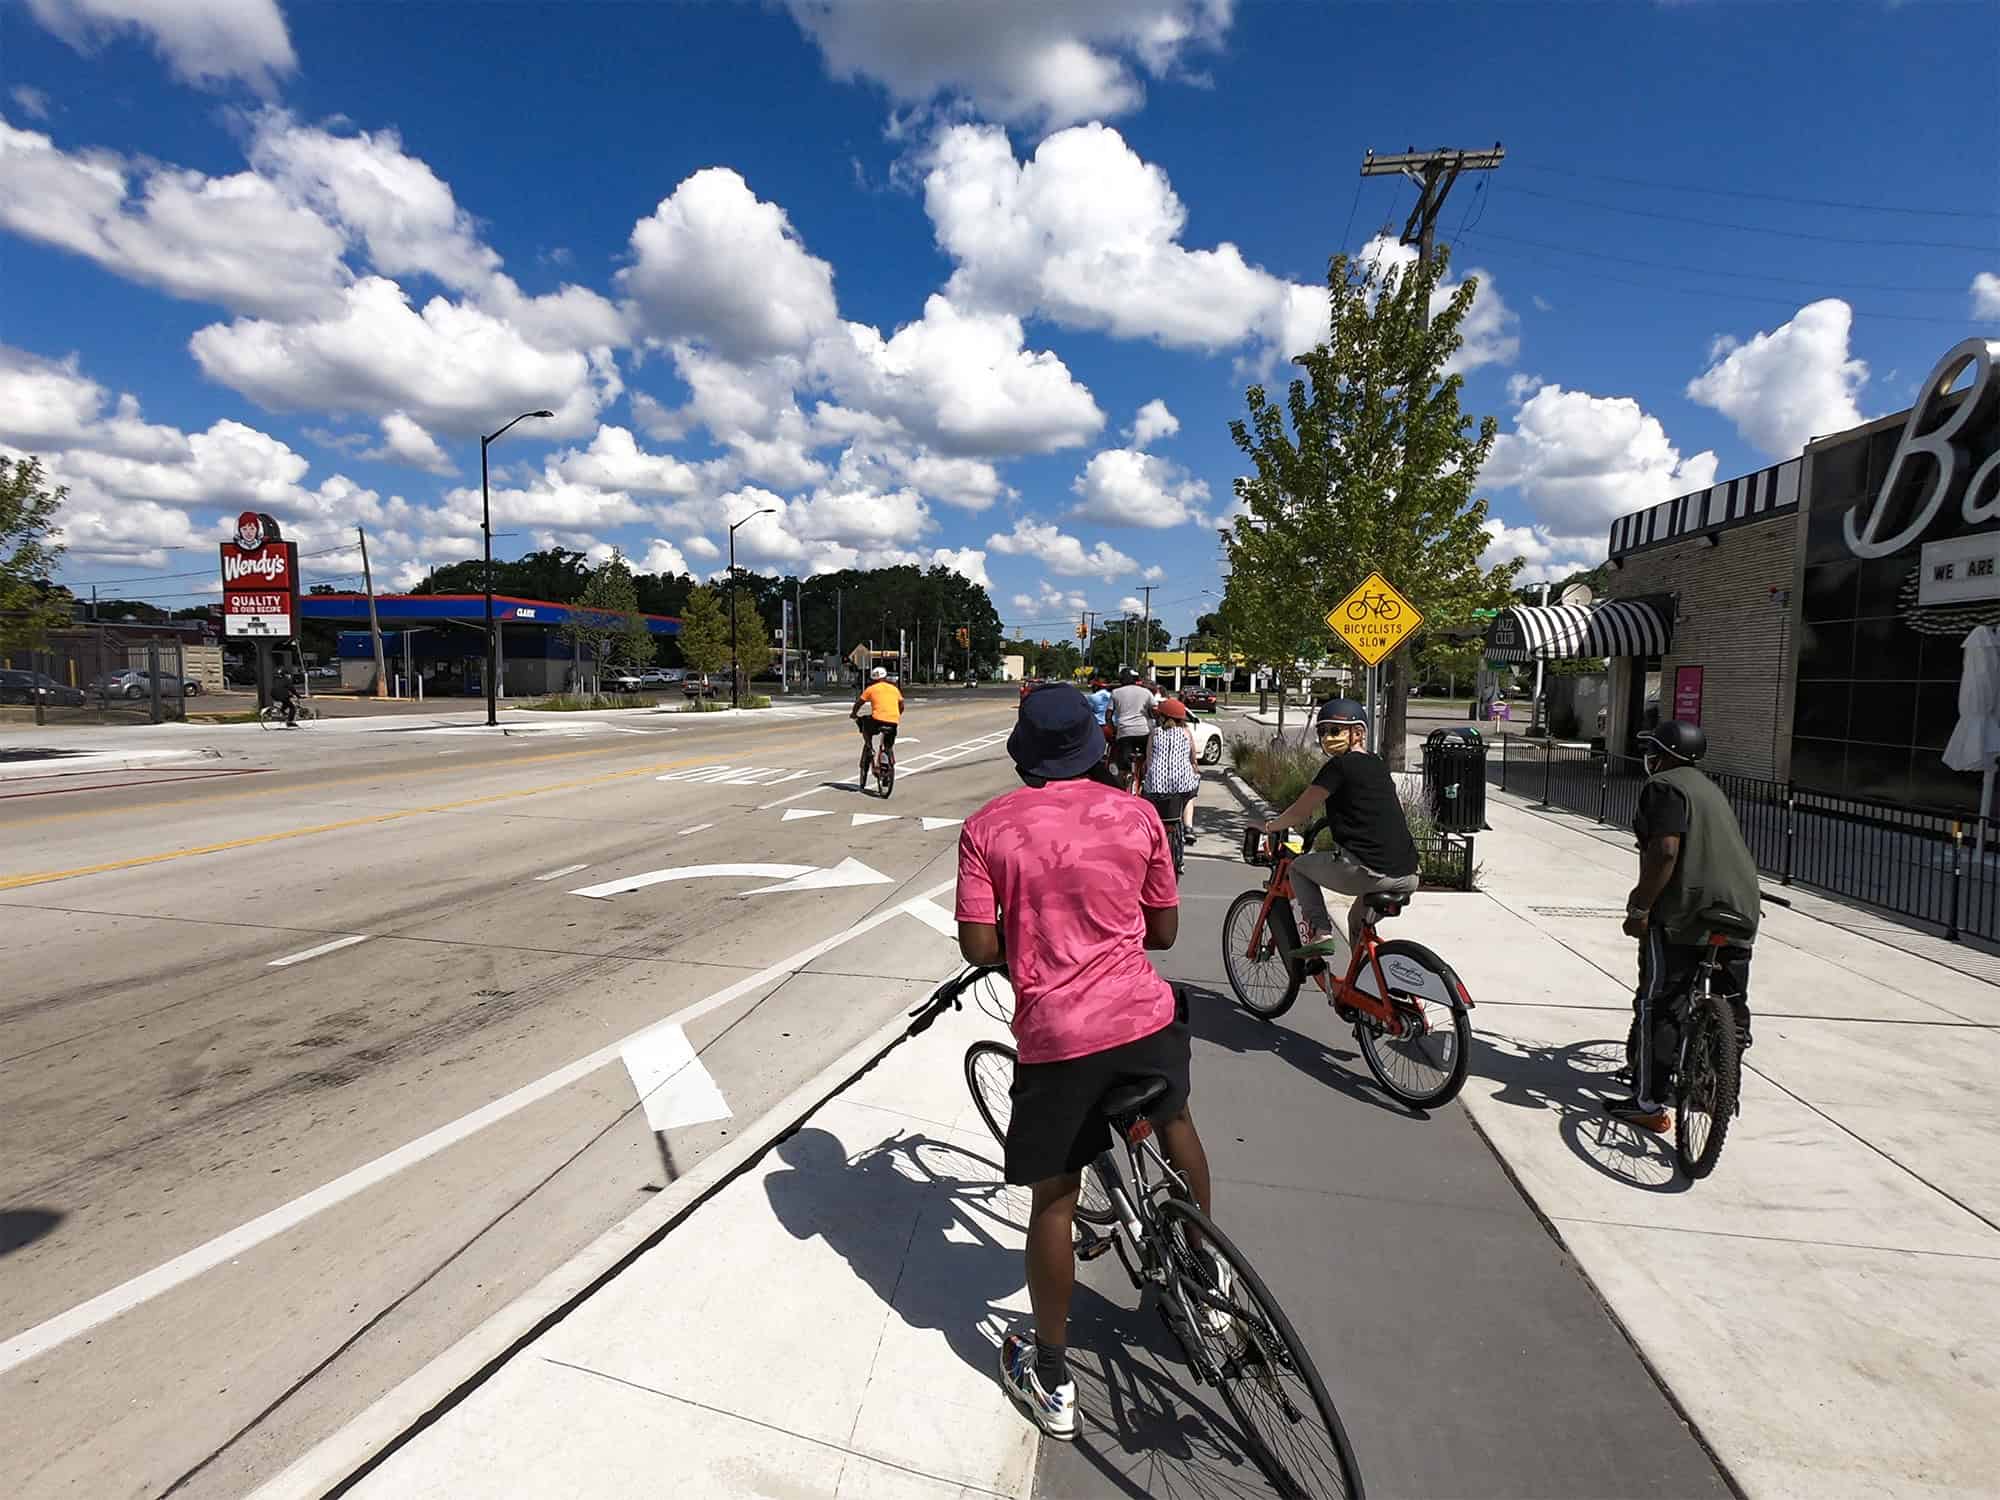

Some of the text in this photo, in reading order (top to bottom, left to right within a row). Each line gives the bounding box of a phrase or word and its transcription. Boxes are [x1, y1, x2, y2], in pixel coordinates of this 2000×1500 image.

[223, 549, 285, 581] Wendy's
[1934, 557, 1993, 580] WE ARE
[231, 595, 281, 607] QUALITY
[1344, 623, 1402, 634] BICYCLISTS
[1360, 637, 1387, 648] SLOW
[655, 766, 832, 785] ONLY
